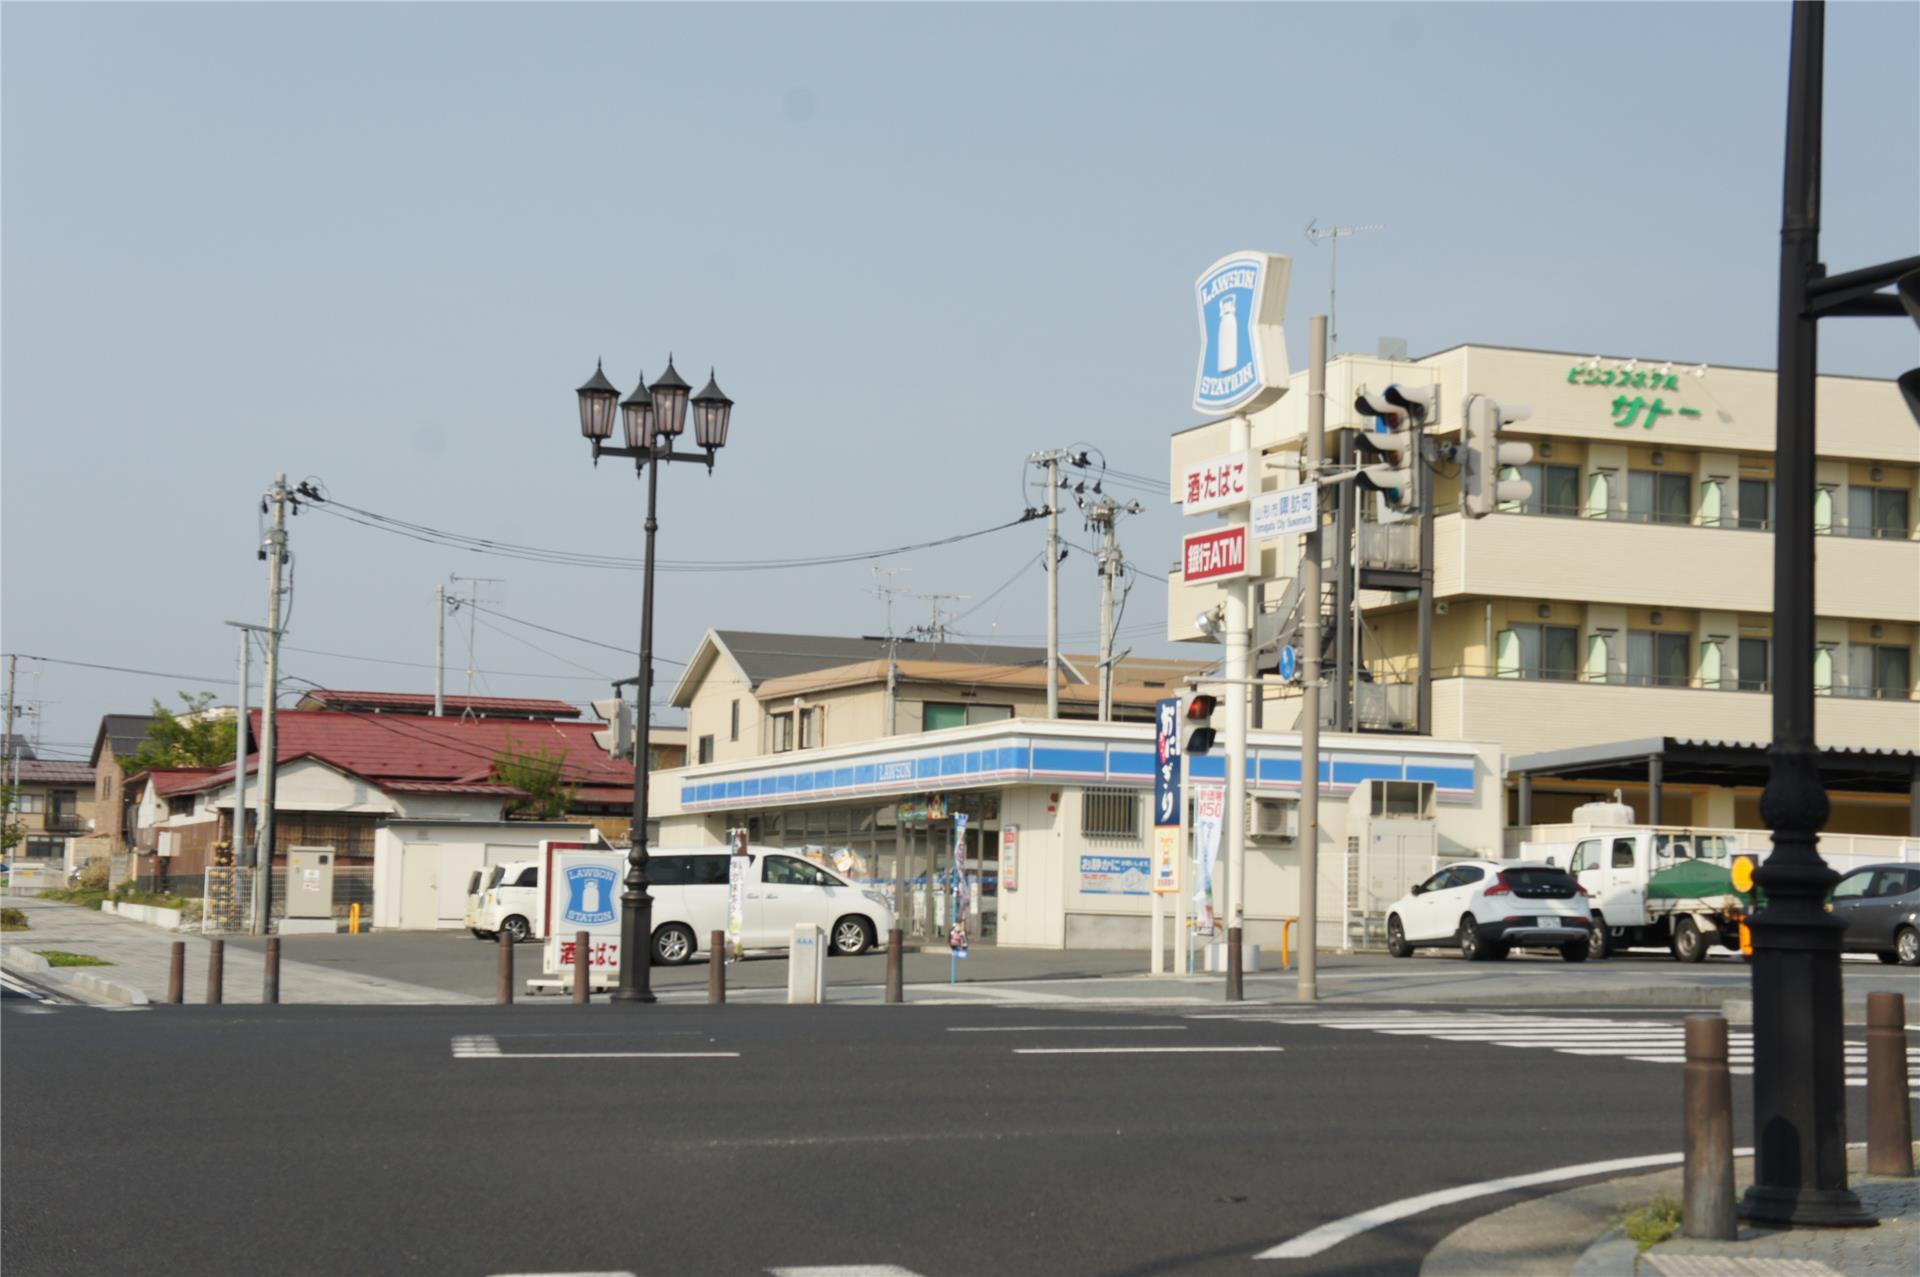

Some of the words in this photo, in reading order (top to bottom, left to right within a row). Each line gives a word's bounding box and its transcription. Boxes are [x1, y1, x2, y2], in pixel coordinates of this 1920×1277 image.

[1202, 269, 1257, 304] LAWSON
[1201, 362, 1253, 396] STATION
[1611, 395, 1701, 429] サトー
[1187, 535, 1243, 574] 銀行ATM
[879, 762, 912, 781] LAWSON
[1160, 703, 1175, 823] おにぎり
[569, 868, 614, 881] LAWSON
[567, 911, 612, 924] STATION
